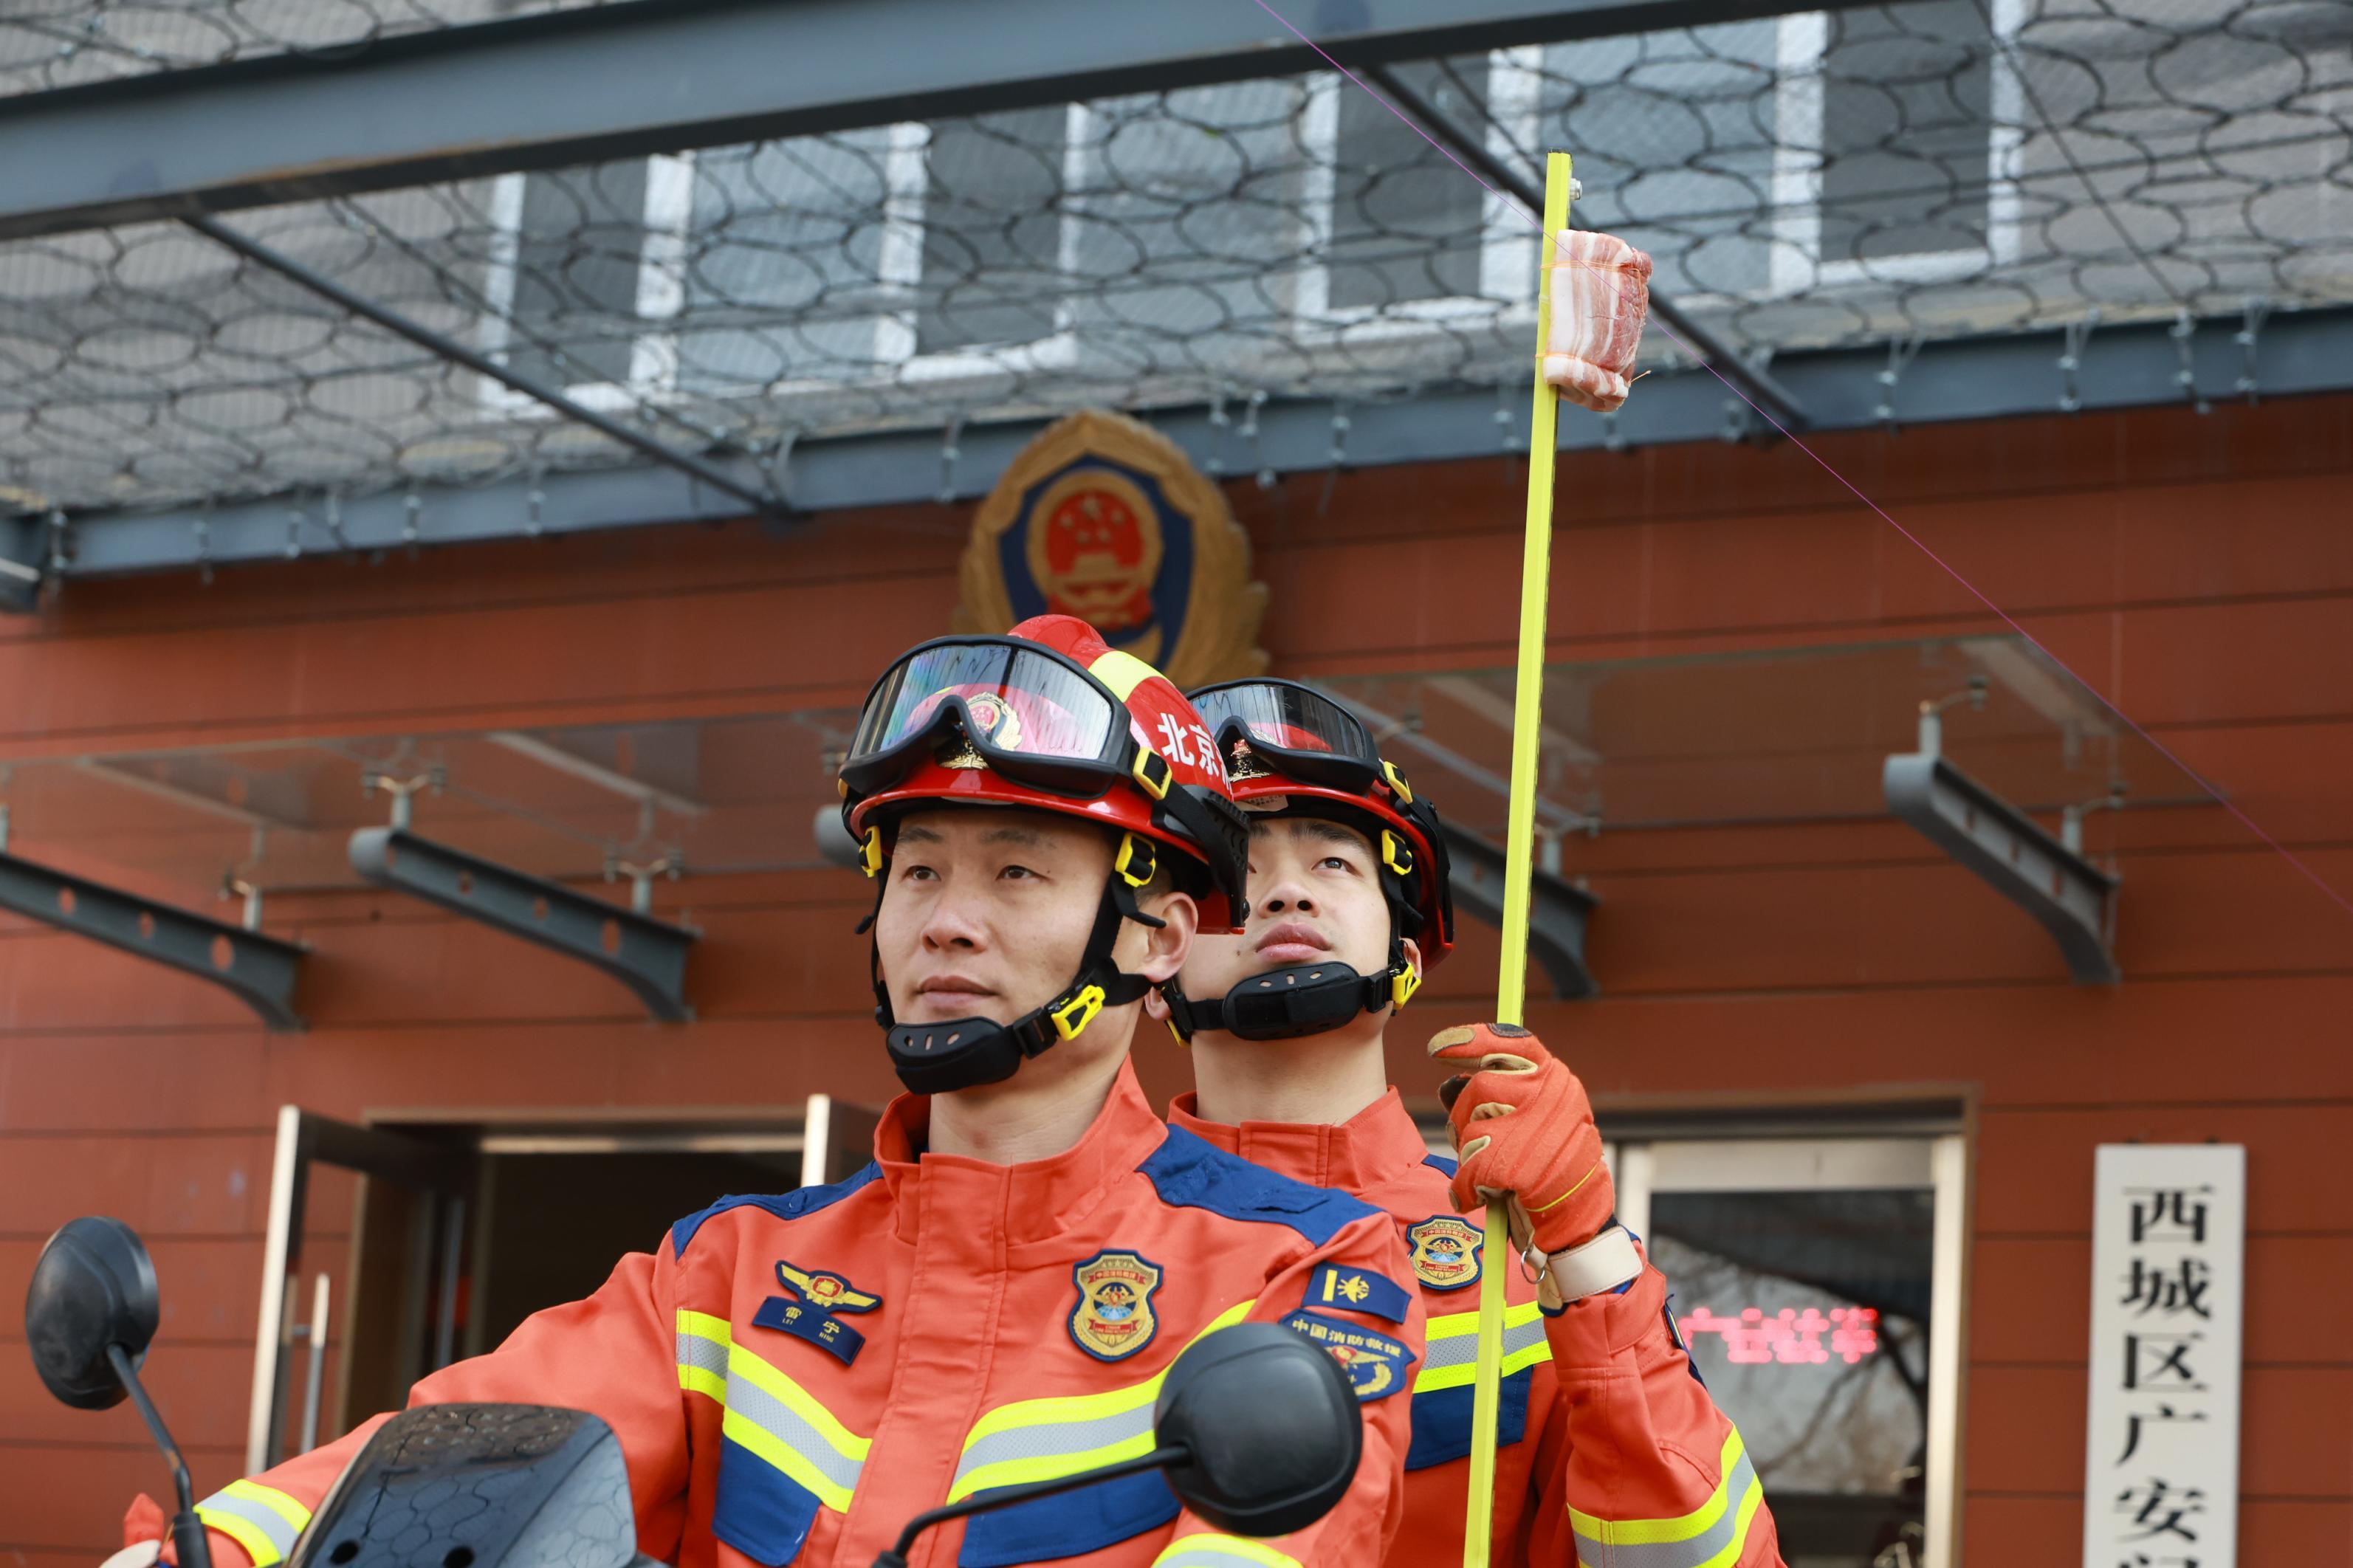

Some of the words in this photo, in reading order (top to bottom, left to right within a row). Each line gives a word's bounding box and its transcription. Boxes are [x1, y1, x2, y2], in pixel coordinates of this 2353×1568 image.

[822, 1321, 839, 1333] 宁
[1292, 1318, 1401, 1358] 中国消防救援
